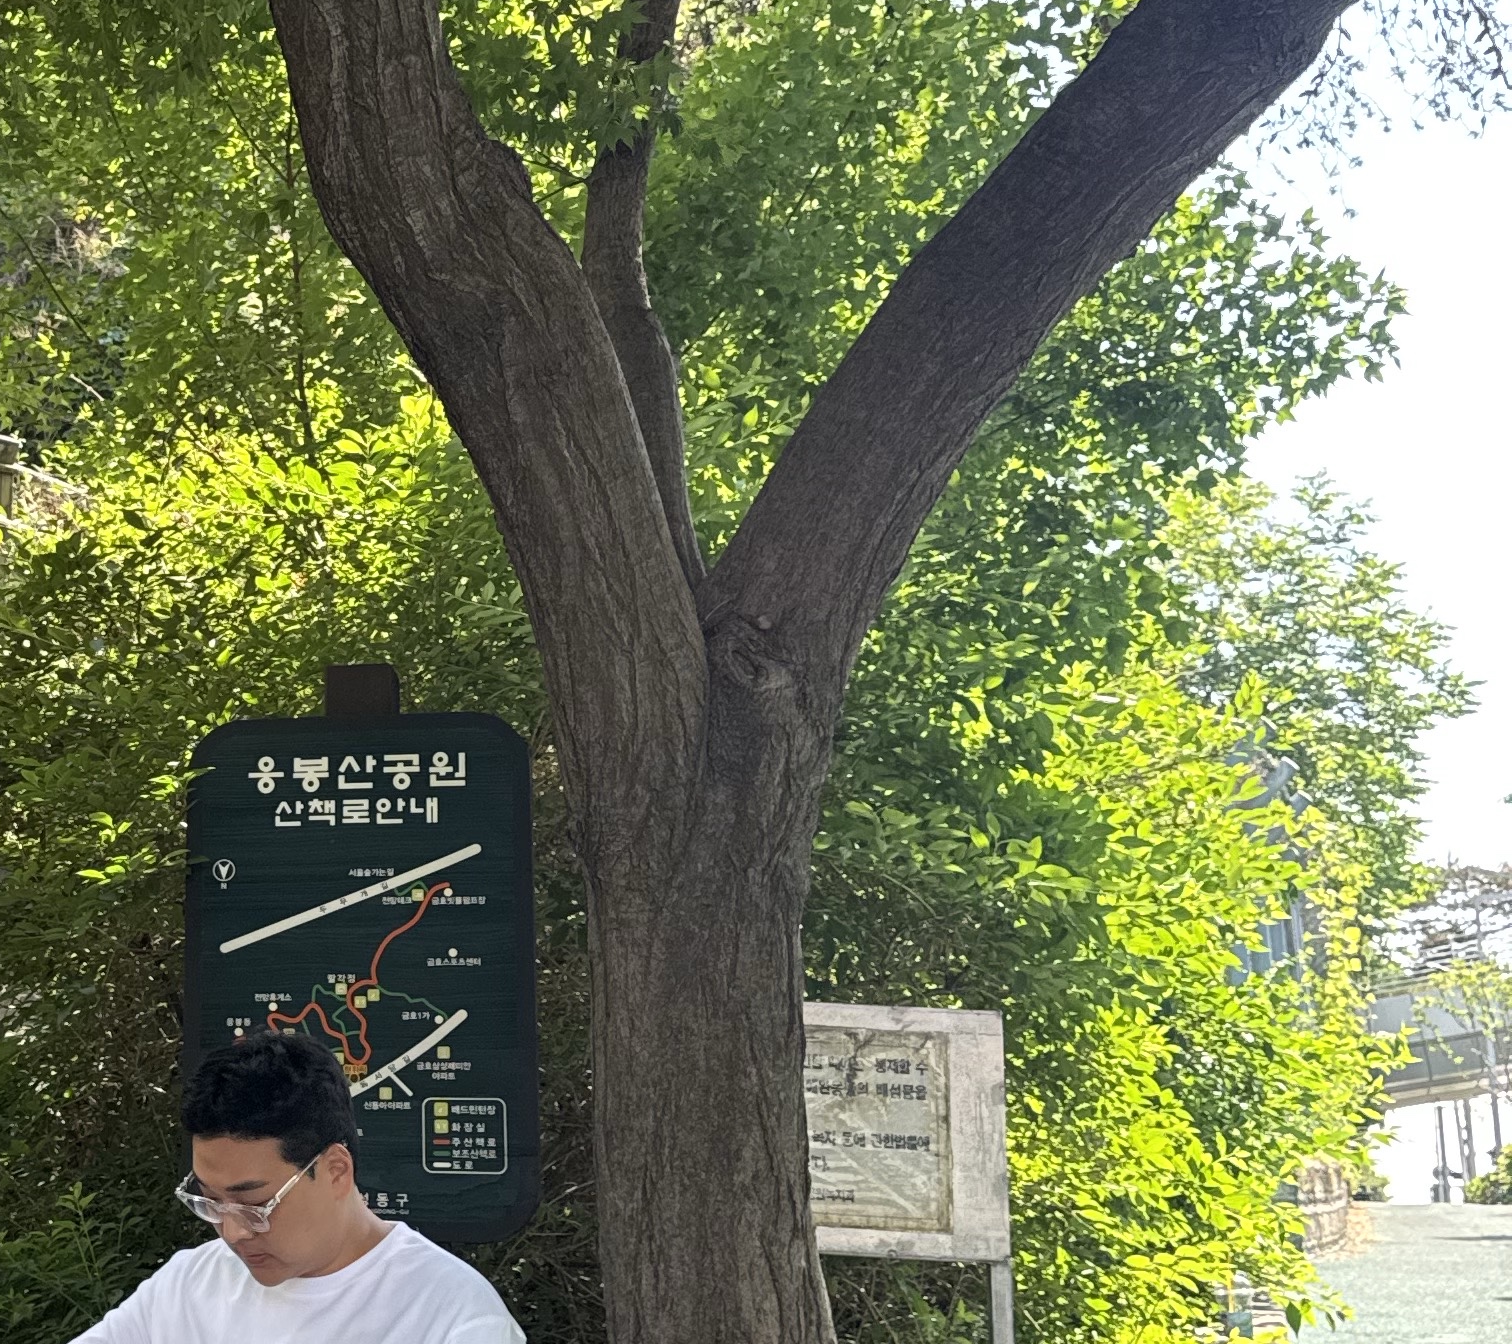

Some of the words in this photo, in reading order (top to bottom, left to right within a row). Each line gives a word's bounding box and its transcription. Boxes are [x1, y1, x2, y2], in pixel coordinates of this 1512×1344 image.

[247, 751, 467, 794] 응봉산공원
[274, 796, 439, 827] 산책로안내
[400, 1011, 431, 1021] 금호1가
[450, 1105, 497, 1116] 배드민턴장
[451, 1122, 486, 1133] 화장실
